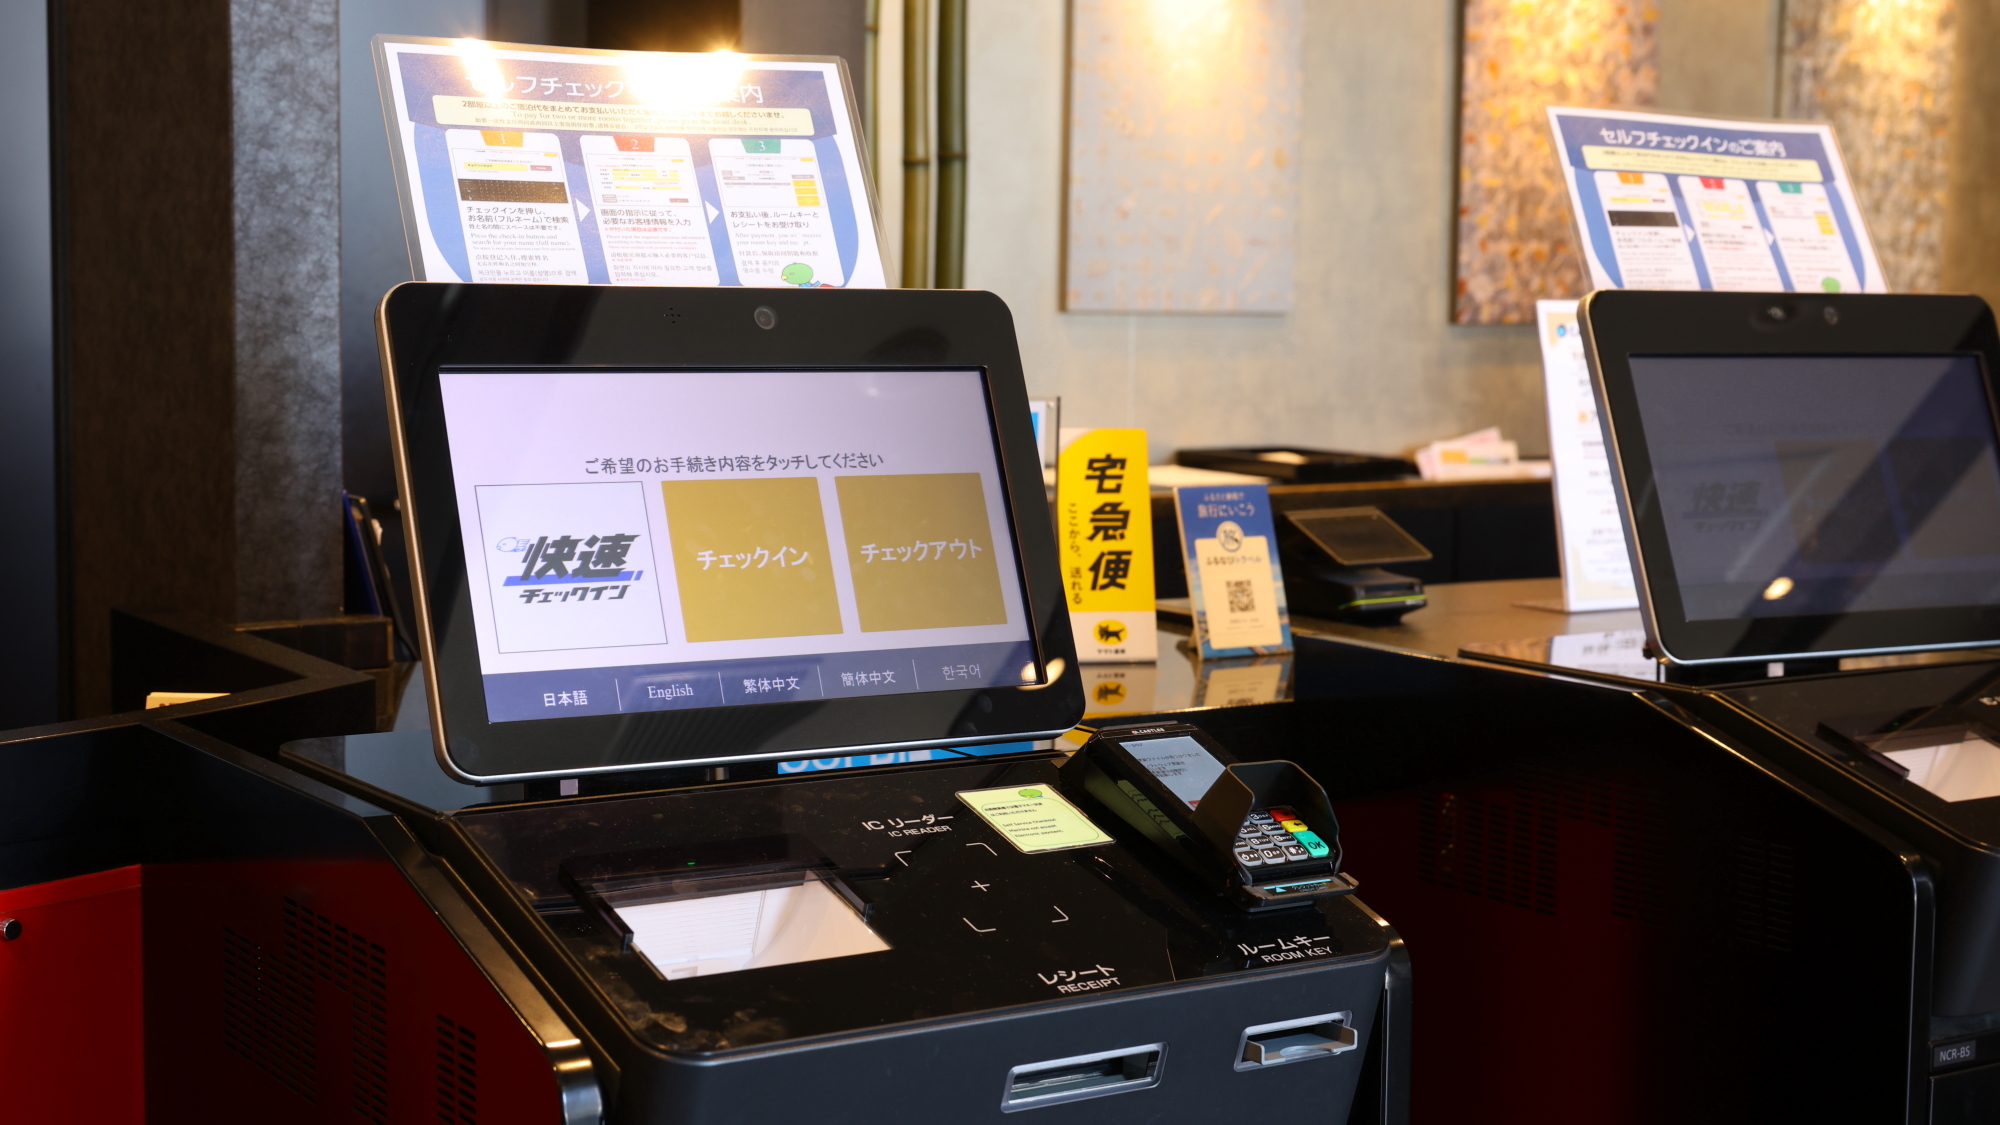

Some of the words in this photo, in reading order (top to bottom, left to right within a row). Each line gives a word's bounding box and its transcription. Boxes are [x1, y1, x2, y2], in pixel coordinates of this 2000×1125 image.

[524, 112, 538, 120] pay
[656, 116, 680, 125] please
[499, 134, 506, 144] 1
[631, 138, 640, 150] 2
[758, 141, 765, 151] 3
[1599, 127, 1787, 158] セルフチェックインのご案内
[466, 206, 546, 215] チェックインを押し、
[600, 209, 677, 217] 画面の指示に従って、
[603, 218, 691, 226] 必要なお客様情報を入力
[584, 452, 884, 476] ご希望のお手続き内容をタッチしてください
[1197, 502, 1255, 518] 旅行にいこう
[1085, 453, 1133, 592] 宅急便
[519, 533, 641, 581] 快速
[697, 546, 808, 571] チェックイン
[861, 539, 983, 564] チェックアウト
[1068, 502, 1082, 605] ここから、送れる
[518, 585, 631, 604] チェックイン
[842, 669, 897, 687] 簡体中文
[942, 663, 982, 681] 한국어
[647, 682, 694, 701] English
[743, 675, 800, 695] 繁体中文
[543, 690, 588, 708] 日本語
[861, 820, 885, 831] IC
[887, 814, 954, 828] リーダー
[887, 830, 902, 838] IC
[903, 825, 952, 836] READER
[1308, 841, 1325, 850] OK
[1237, 935, 1331, 956] ルームキー
[1261, 950, 1305, 963] ROOM
[1306, 946, 1332, 957] KEY
[1038, 964, 1115, 985] レシート
[1056, 976, 1121, 994] RECEIPT
[1939, 1045, 1971, 1062] NCR-BS
